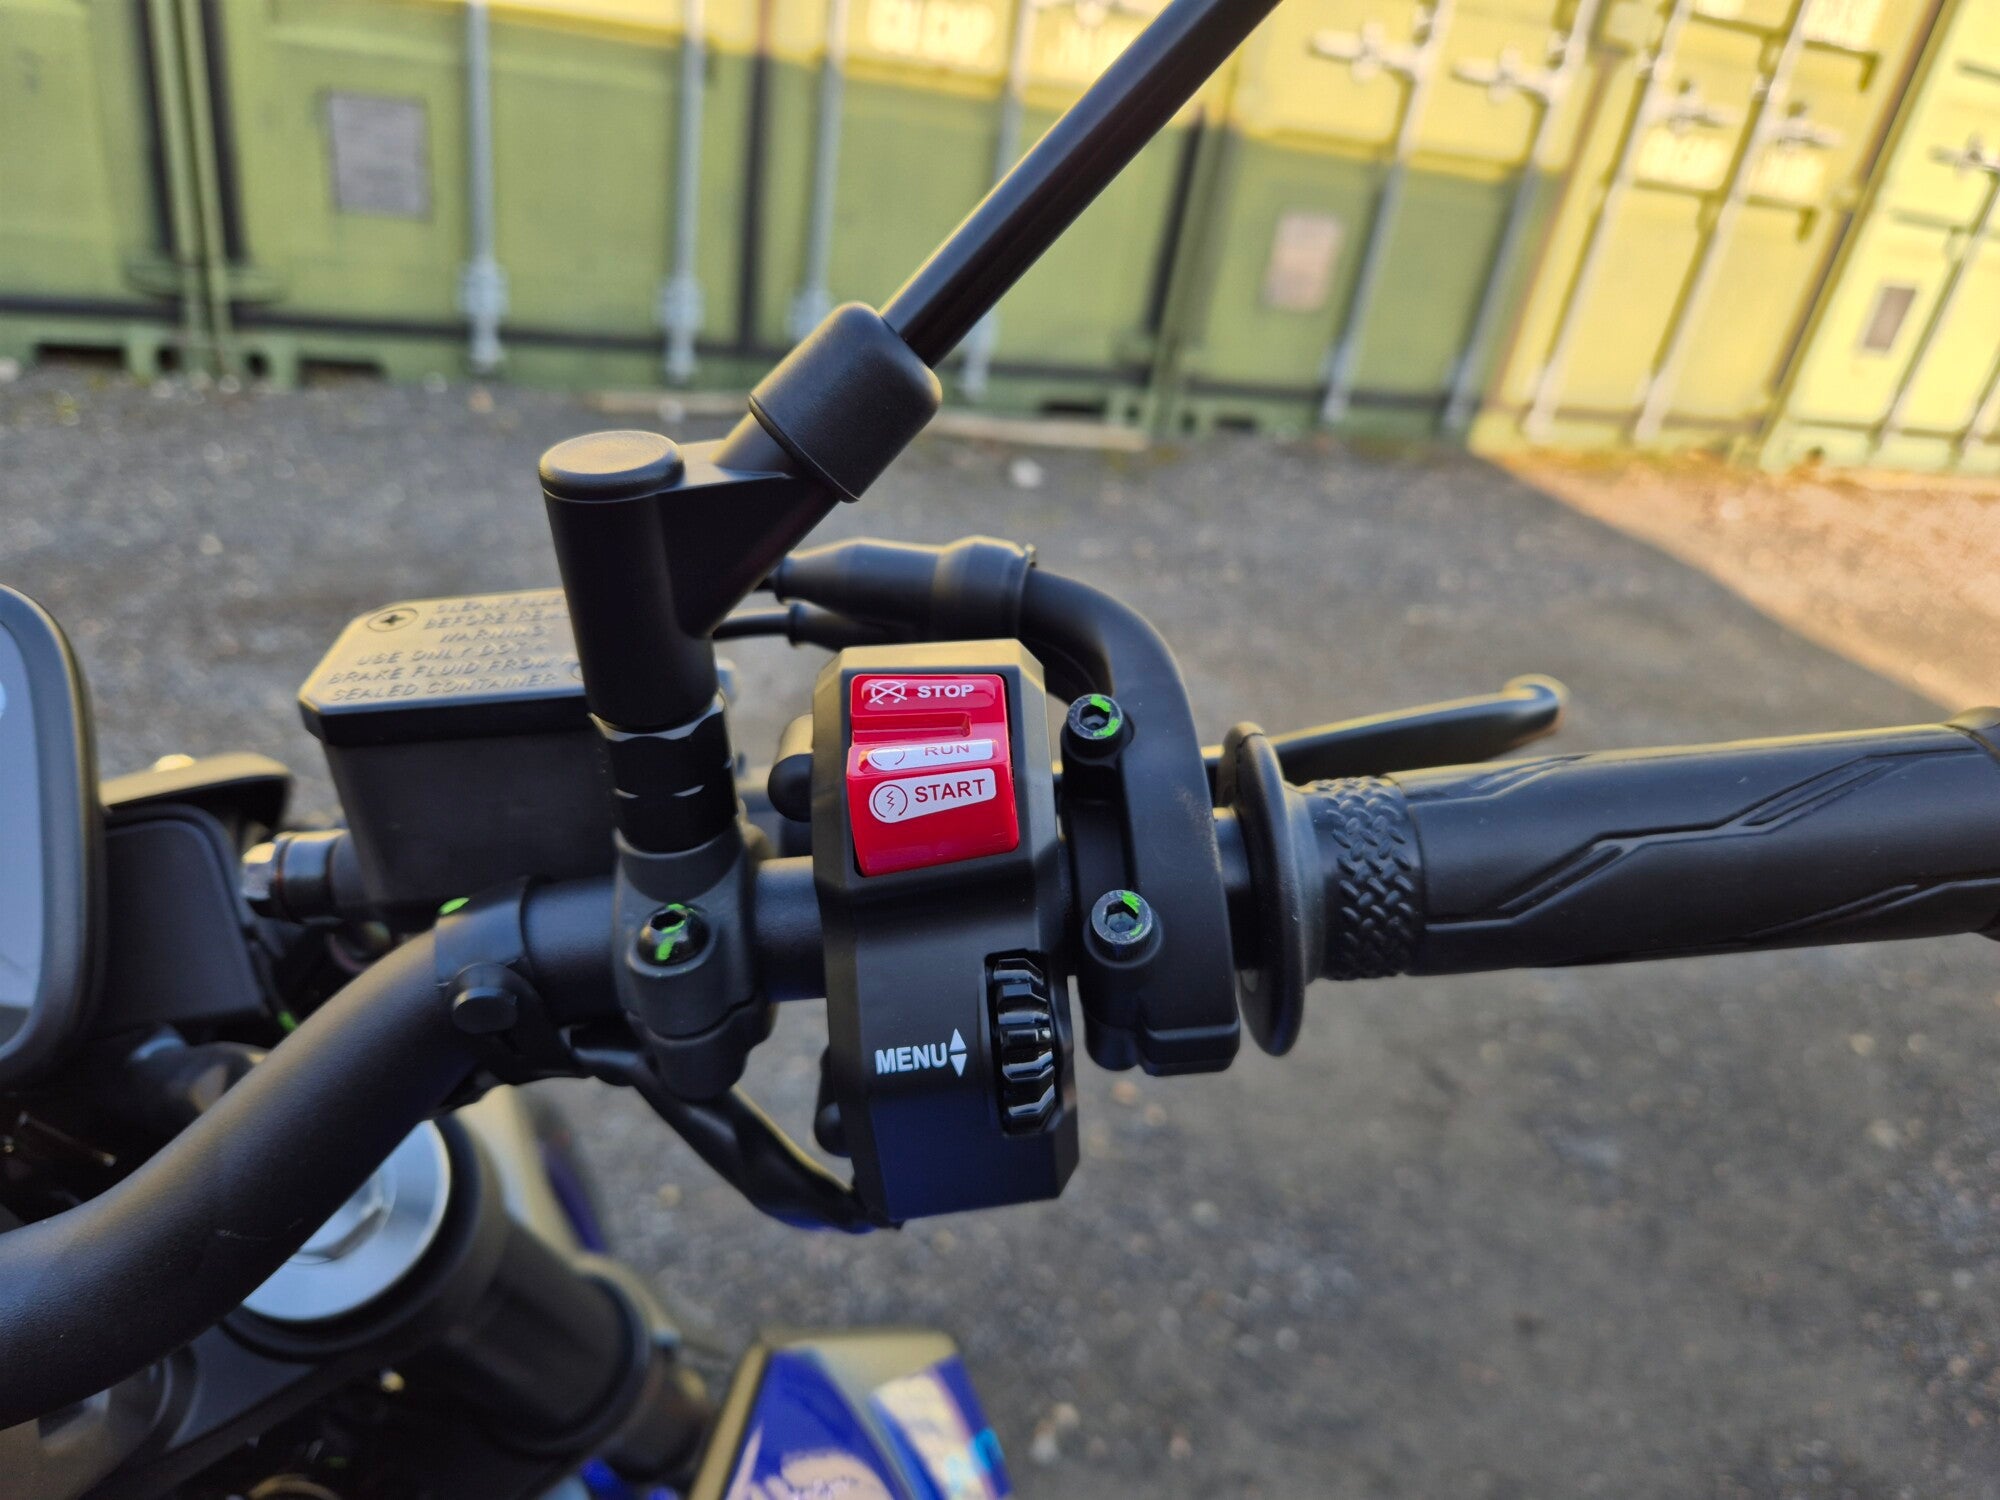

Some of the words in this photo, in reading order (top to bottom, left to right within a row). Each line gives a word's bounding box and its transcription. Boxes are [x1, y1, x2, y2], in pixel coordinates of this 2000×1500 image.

[357, 651, 402, 666] USE
[328, 667, 404, 684] BRAKE
[412, 660, 479, 678] FLUID
[331, 683, 418, 701] SEALED
[427, 673, 558, 695] CONTAINER
[917, 684, 975, 698] STOP
[924, 744, 970, 756] RUN
[914, 778, 986, 803] START
[875, 1042, 947, 1075] MENU
